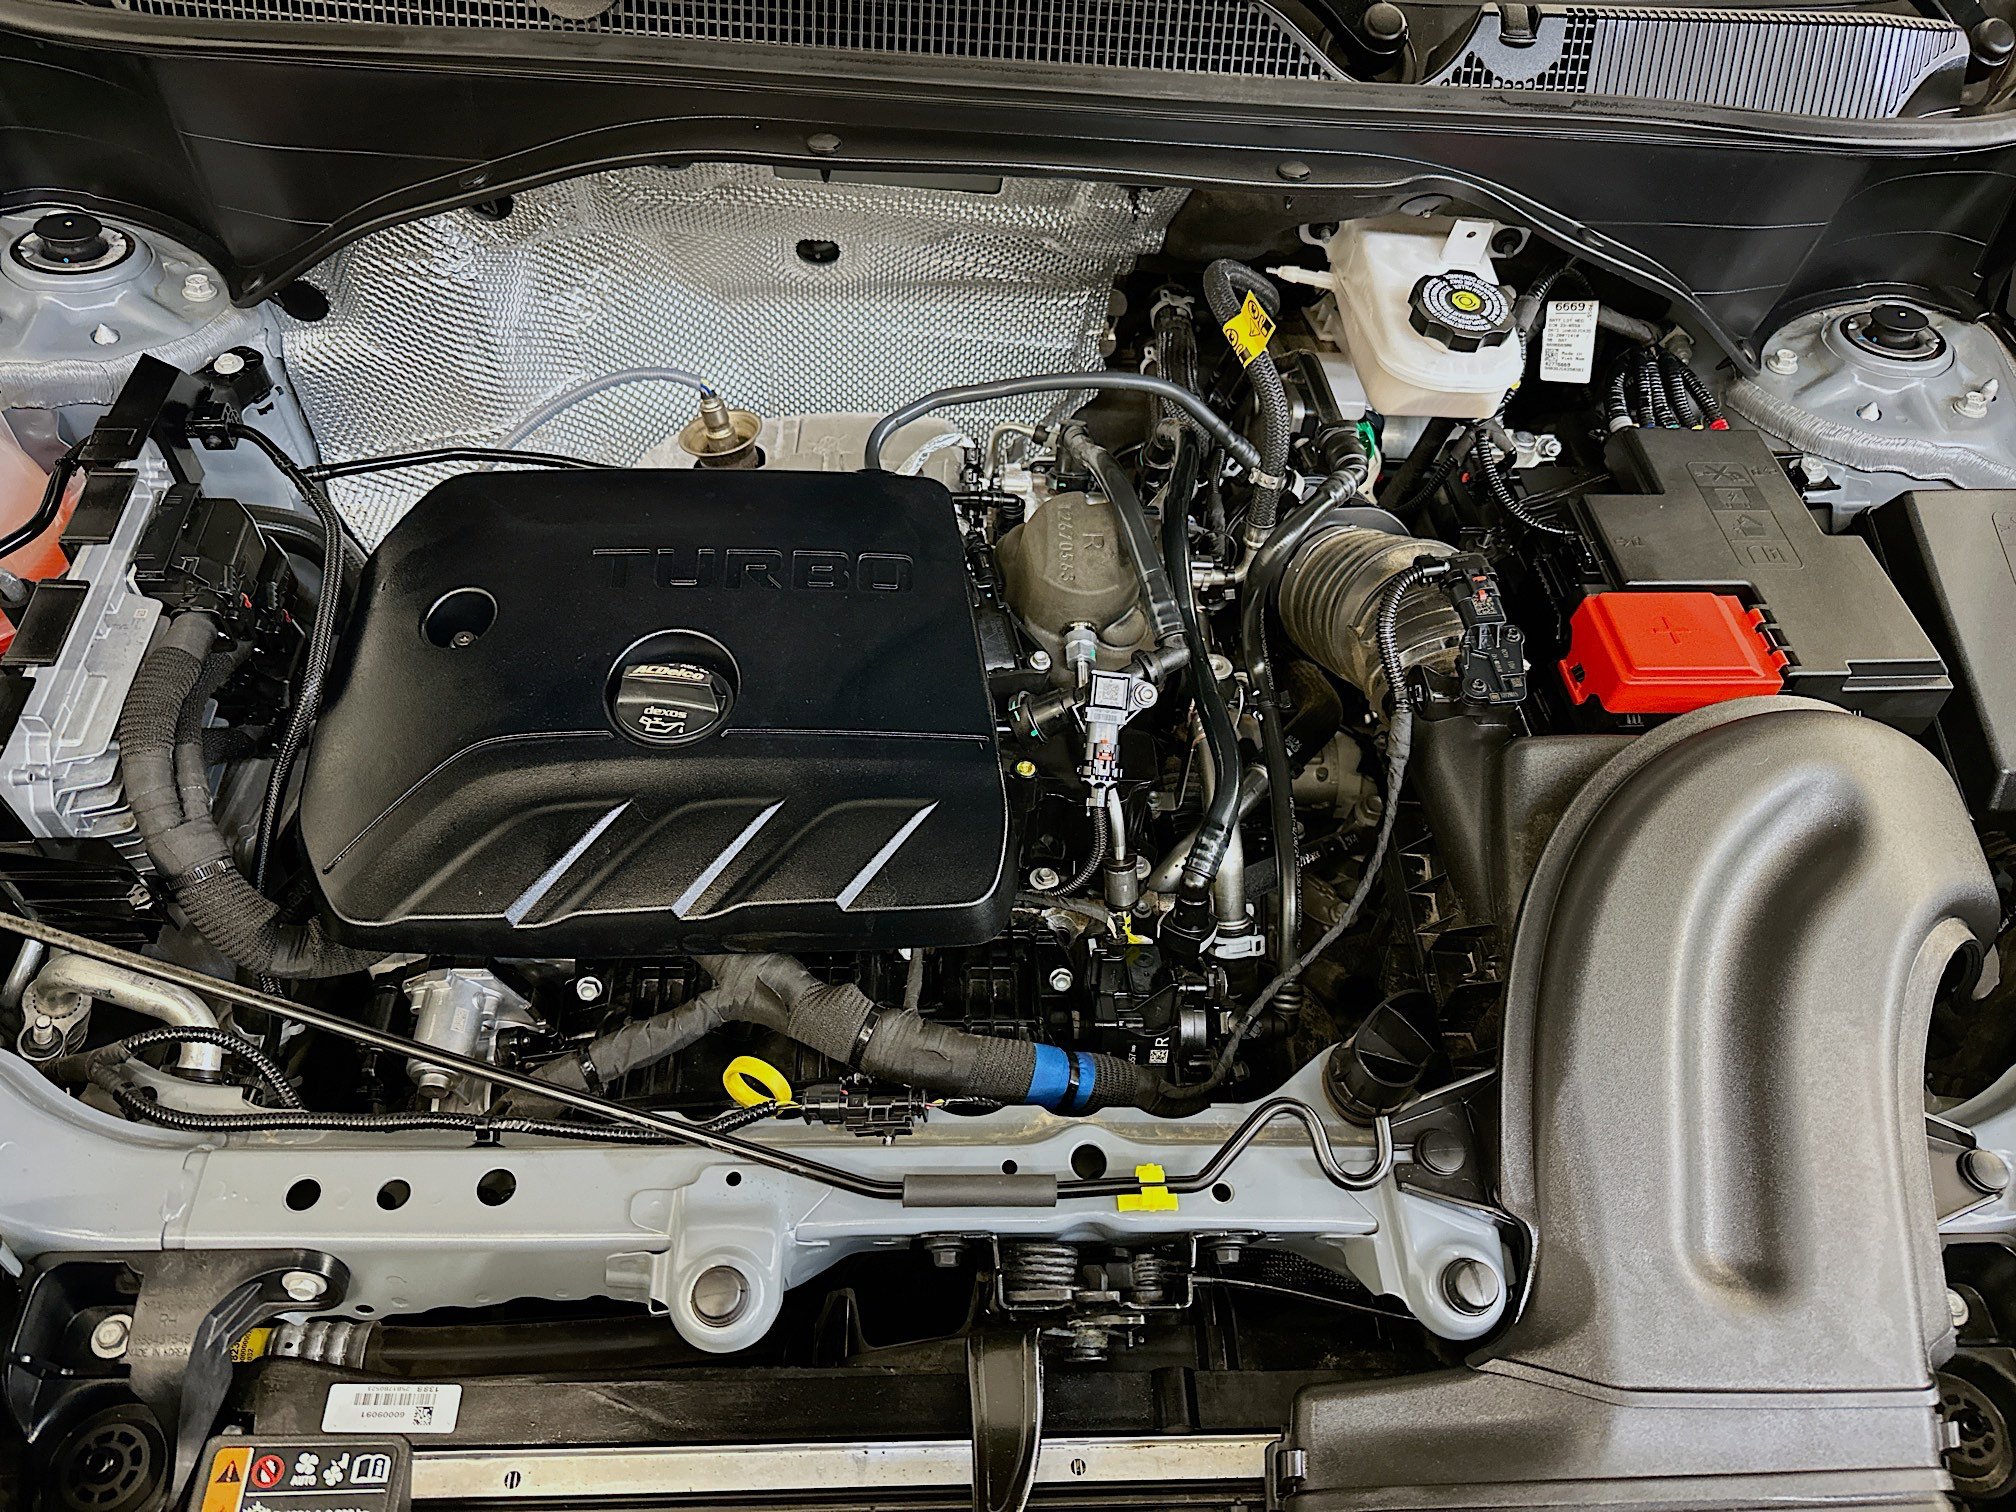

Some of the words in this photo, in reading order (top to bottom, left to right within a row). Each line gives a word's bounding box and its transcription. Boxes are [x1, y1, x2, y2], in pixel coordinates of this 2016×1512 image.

[1555, 302, 1586, 312] 6669
[593, 548, 914, 593] TURBO
[628, 665, 705, 680] ACDelco
[643, 706, 688, 719] dexos
[1154, 1037, 1170, 1047] R
[290, 1474, 318, 1487] AUTO
